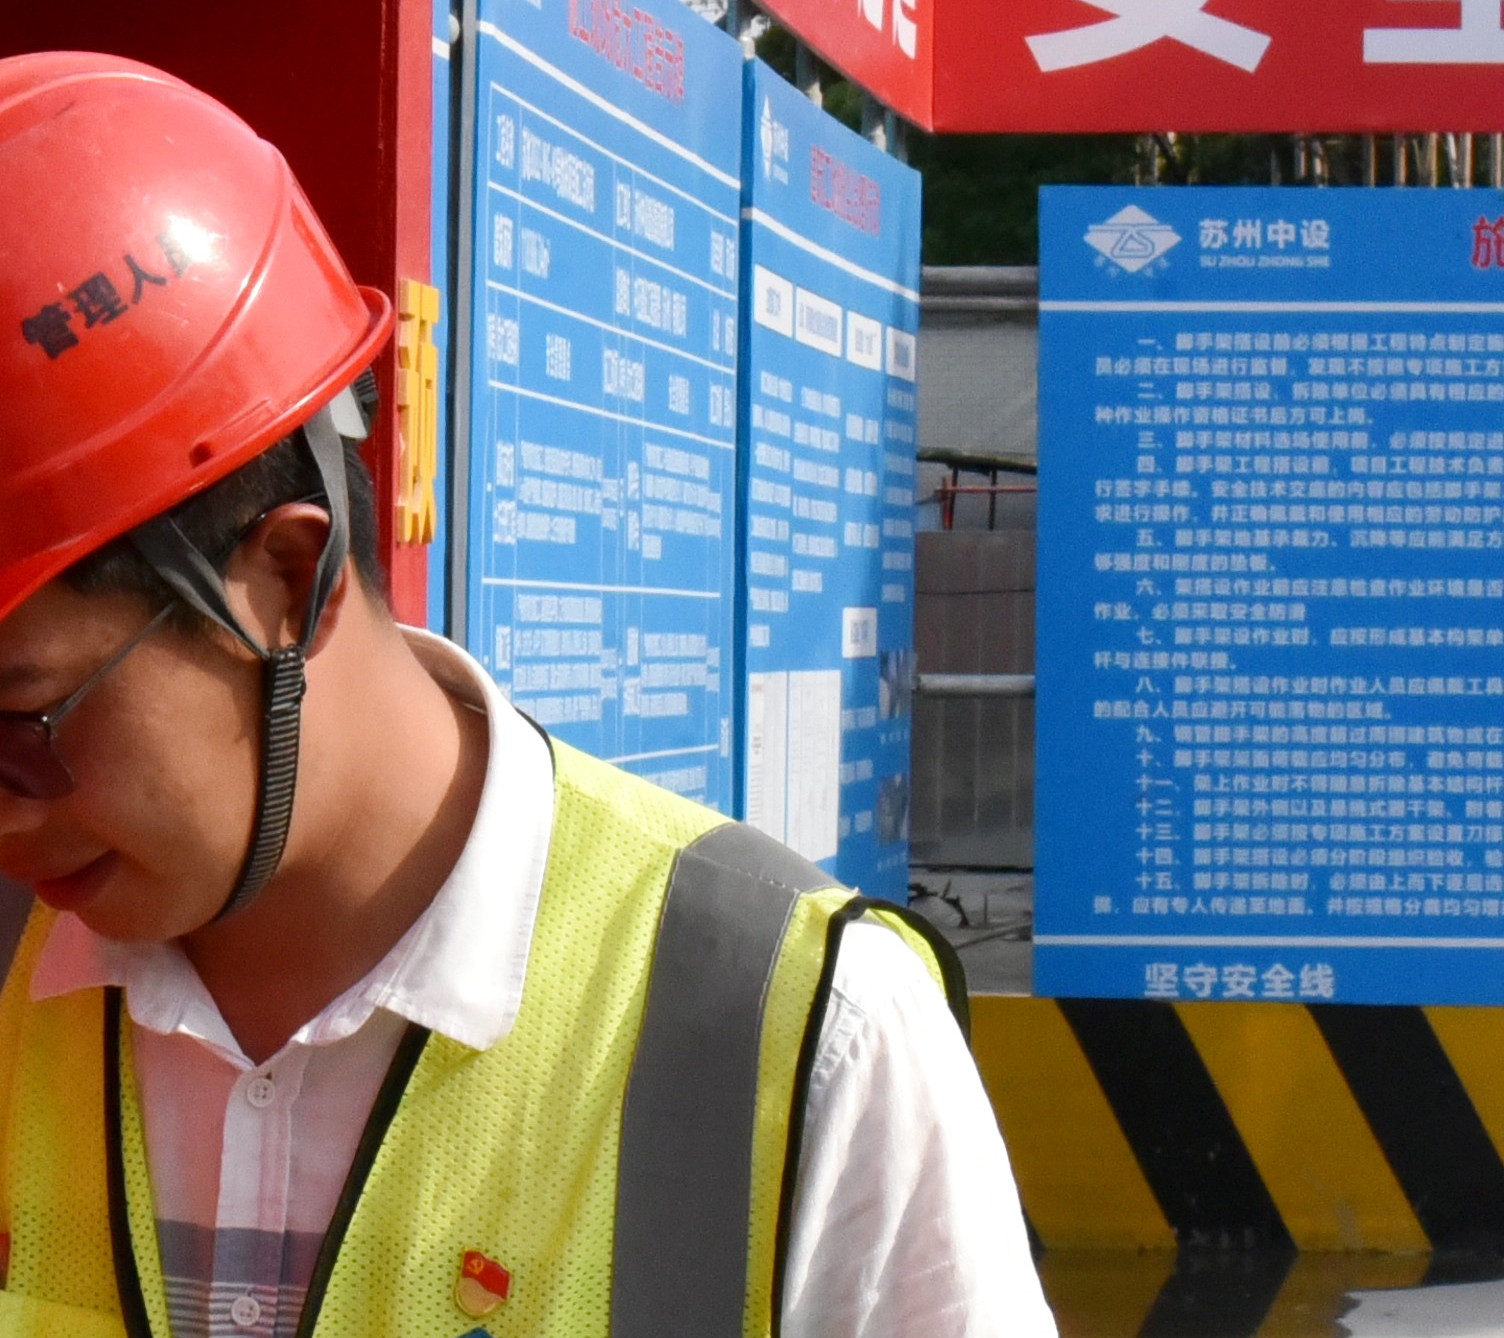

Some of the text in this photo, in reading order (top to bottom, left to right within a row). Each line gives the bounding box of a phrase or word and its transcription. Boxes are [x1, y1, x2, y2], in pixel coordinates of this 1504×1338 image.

[1199, 219, 1331, 249] 苏州中设
[1144, 964, 1335, 998] 坚守安全线
